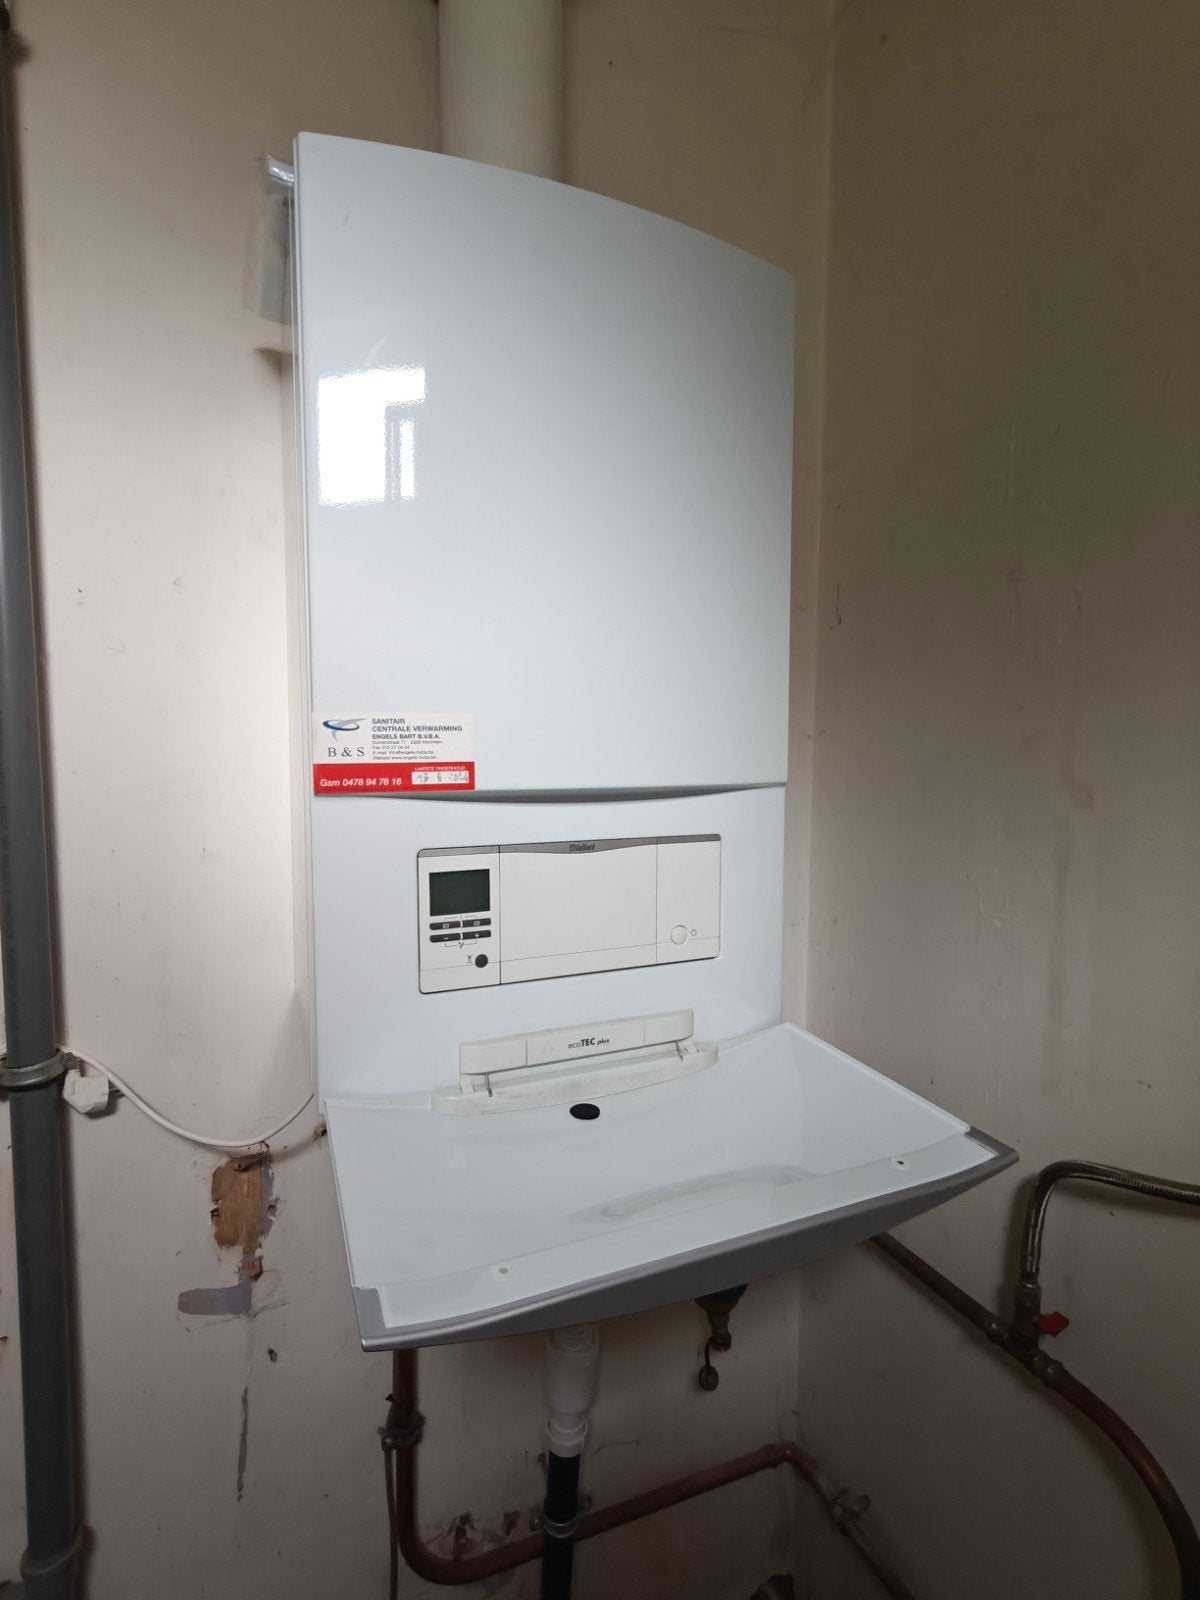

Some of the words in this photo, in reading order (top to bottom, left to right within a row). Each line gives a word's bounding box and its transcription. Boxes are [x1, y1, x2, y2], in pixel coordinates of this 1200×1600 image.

[328, 747, 337, 757] B
[341, 747, 352, 757] &
[357, 747, 365, 757] S
[320, 779, 341, 787] Gsm
[342, 778, 364, 786] 0478
[365, 778, 376, 786] 94
[568, 1037, 595, 1049] ecoTEC
[597, 1037, 609, 1045] plus
